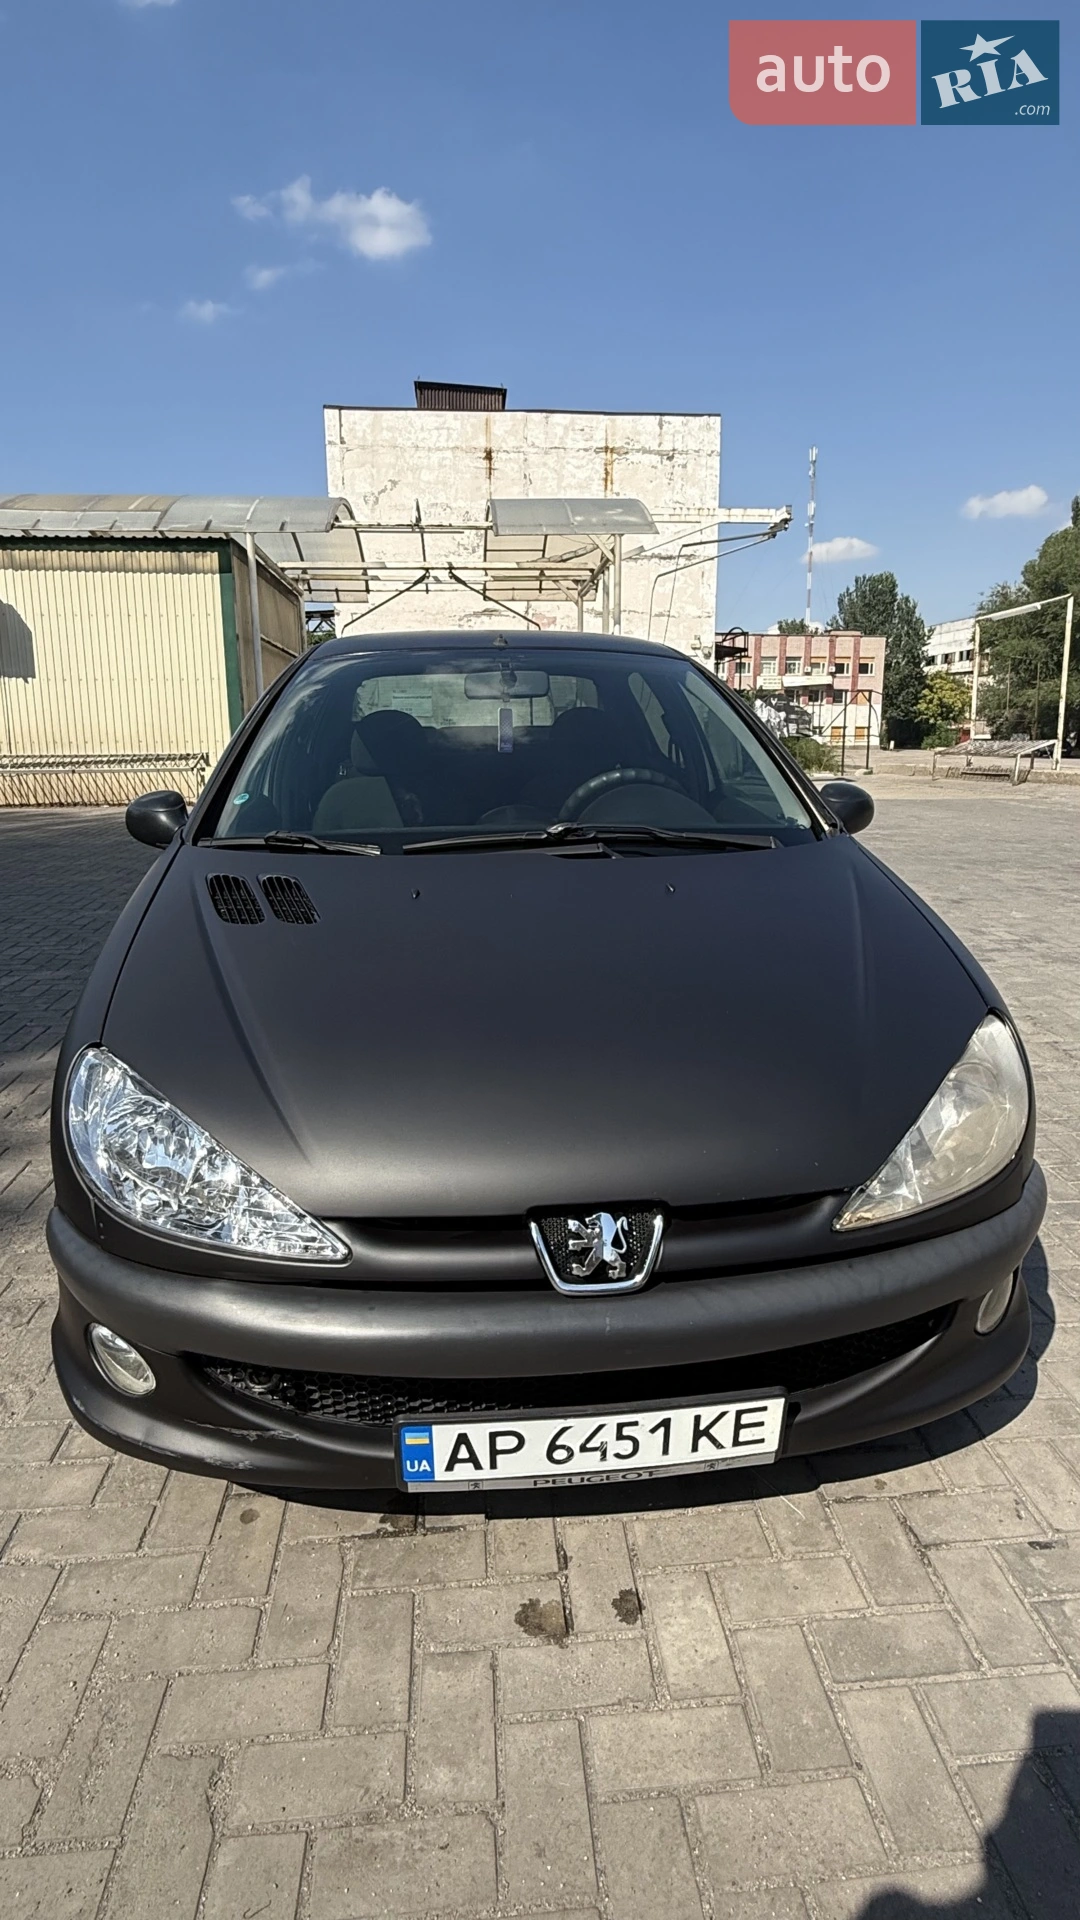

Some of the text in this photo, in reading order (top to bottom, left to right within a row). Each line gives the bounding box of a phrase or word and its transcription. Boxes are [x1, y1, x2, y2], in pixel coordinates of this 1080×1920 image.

[444, 1405, 769, 1473] AP 6451 KE
[406, 1459, 431, 1473] UA
[533, 1470, 656, 1488] PEUGEOT
